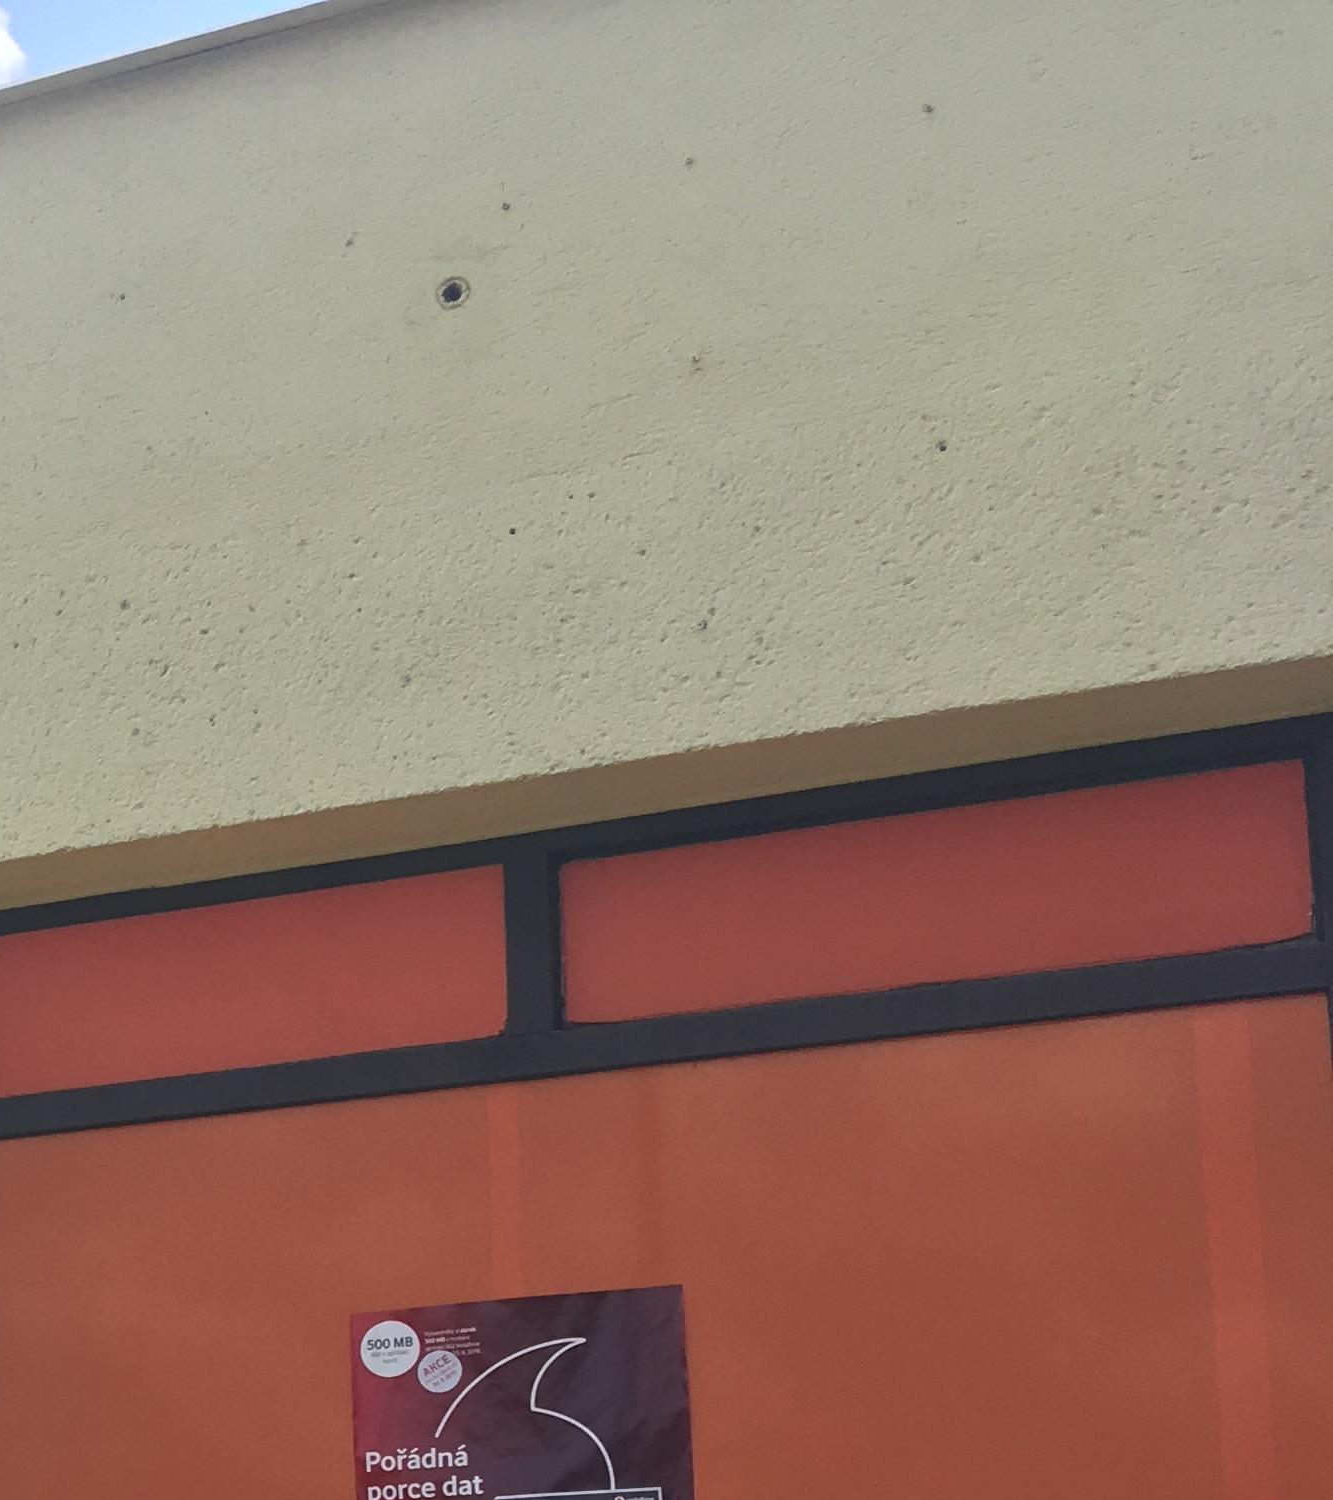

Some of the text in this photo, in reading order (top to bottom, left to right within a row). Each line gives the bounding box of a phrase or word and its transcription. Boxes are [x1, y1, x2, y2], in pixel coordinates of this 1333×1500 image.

[366, 1338, 391, 1351] 500
[393, 1336, 414, 1348] MB
[365, 1444, 468, 1472] Pořádná
[442, 1475, 484, 1496] dat
